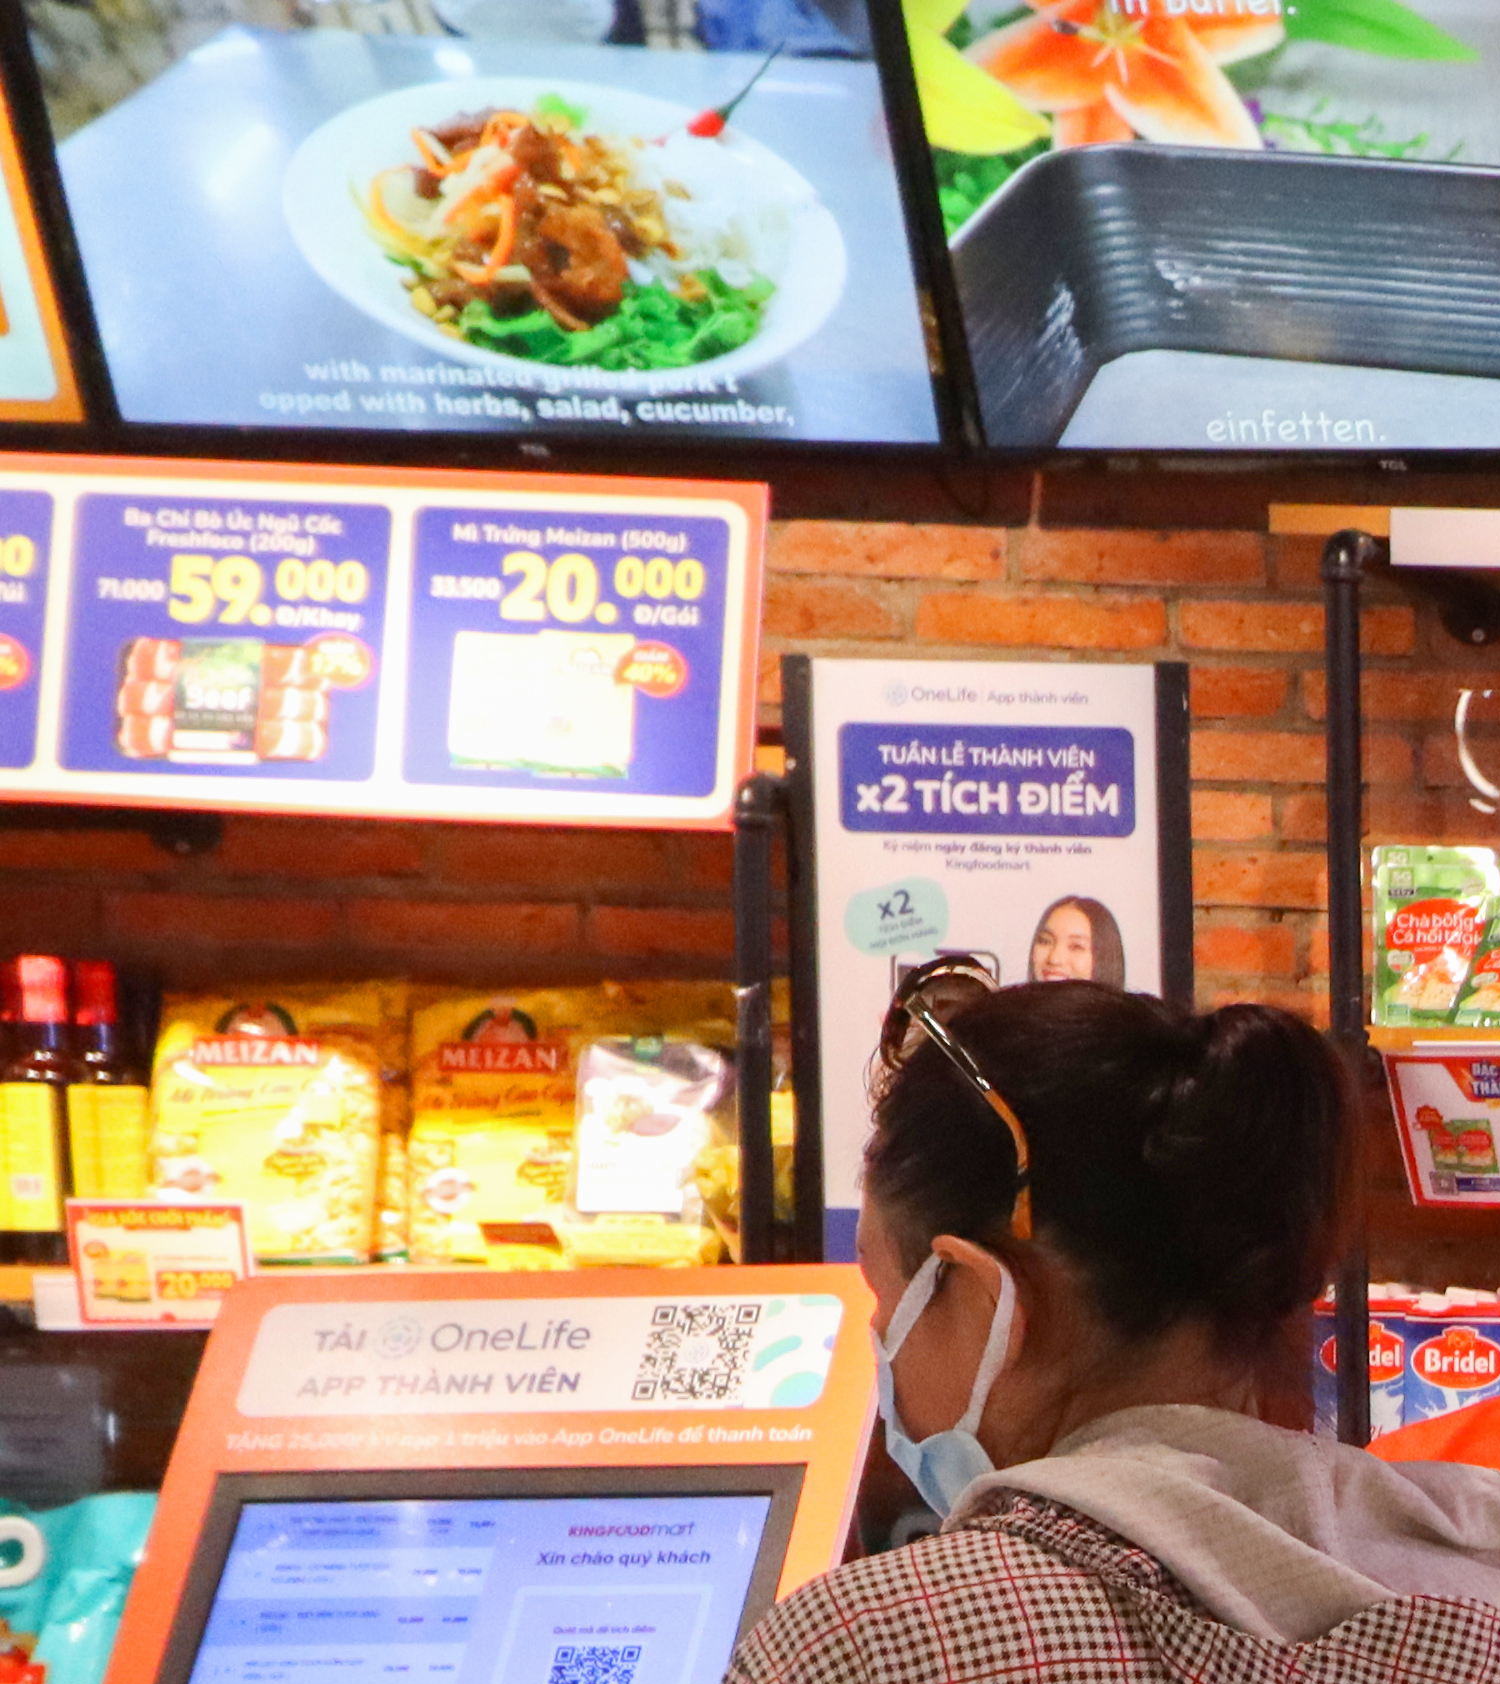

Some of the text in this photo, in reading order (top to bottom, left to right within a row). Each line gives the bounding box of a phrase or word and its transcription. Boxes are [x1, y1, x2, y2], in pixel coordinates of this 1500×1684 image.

[358, 390, 795, 428] with herbs, salad, cucumber,
[1206, 407, 1387, 445] einfetten.
[546, 526, 689, 554] Meizan (500g)
[911, 686, 1016, 705] OneLife App
[969, 742, 1043, 767] THÀNH
[856, 771, 1121, 817] x2 TÍCH ĐIỂM
[1396, 913, 1430, 928] Chà
[195, 1038, 320, 1066] MEIZAN
[440, 1043, 557, 1073] MEIZAN
[429, 1320, 592, 1360] OneLife
[1422, 1346, 1496, 1375] Bridel
[378, 1366, 581, 1398] THÀNH VIÊN
[552, 1424, 814, 1452] App OneLife thanh toán
[536, 1550, 711, 1566] Xin chào khách
